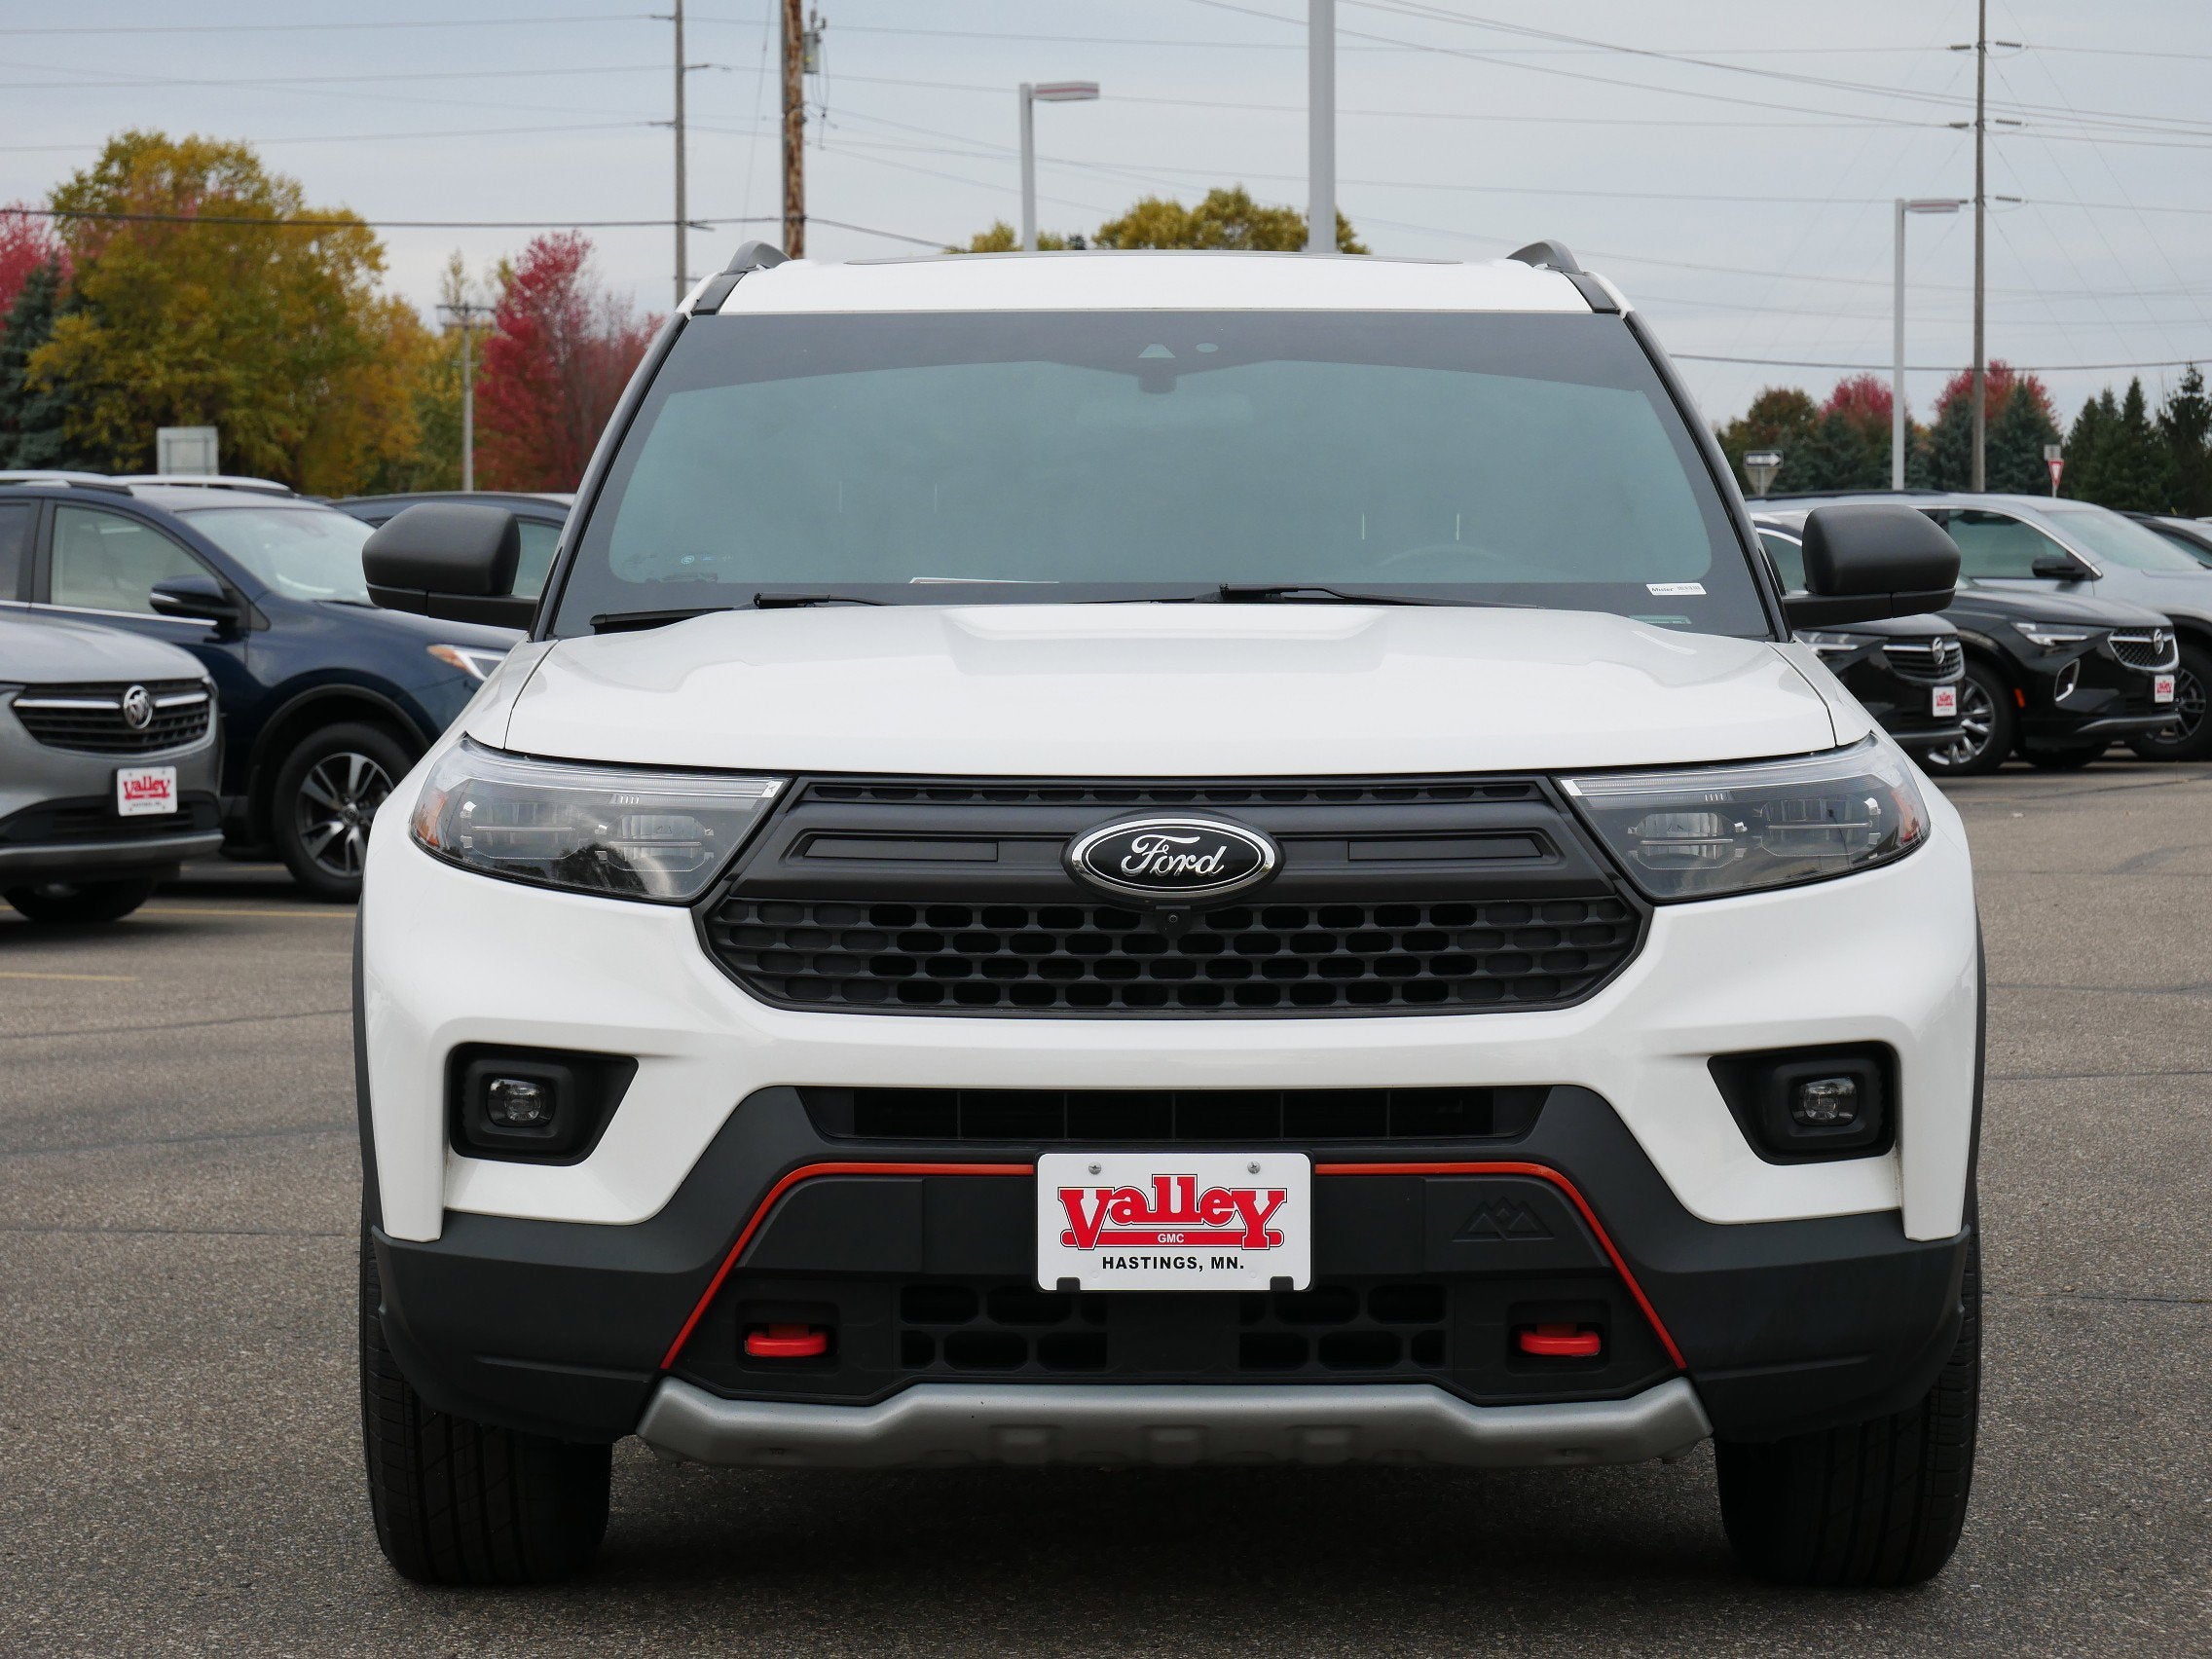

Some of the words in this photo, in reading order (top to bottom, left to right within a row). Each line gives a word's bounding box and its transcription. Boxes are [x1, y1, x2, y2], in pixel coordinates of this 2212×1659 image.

[1121, 833, 1227, 877] Ford
[1057, 1174, 1287, 1250] Valley
[1158, 1234, 1185, 1243] GMC
[1102, 1256, 1203, 1272] HASTINGS,
[1211, 1256, 1244, 1270] MN.
